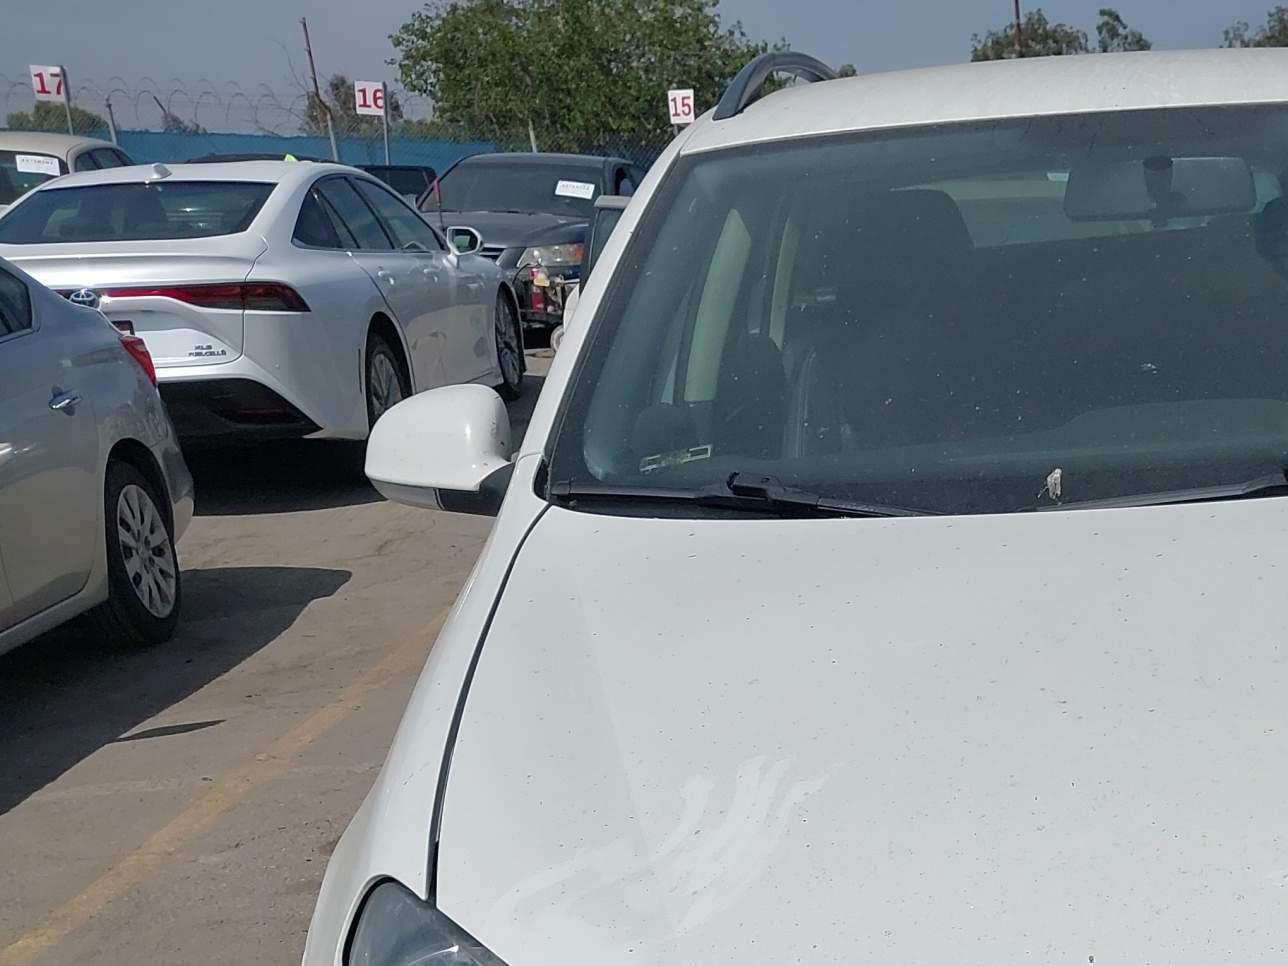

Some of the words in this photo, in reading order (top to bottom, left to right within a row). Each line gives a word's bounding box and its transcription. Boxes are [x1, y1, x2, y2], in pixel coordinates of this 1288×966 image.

[33, 71, 62, 95] 17
[357, 87, 384, 109] 16
[670, 95, 692, 117] 15
